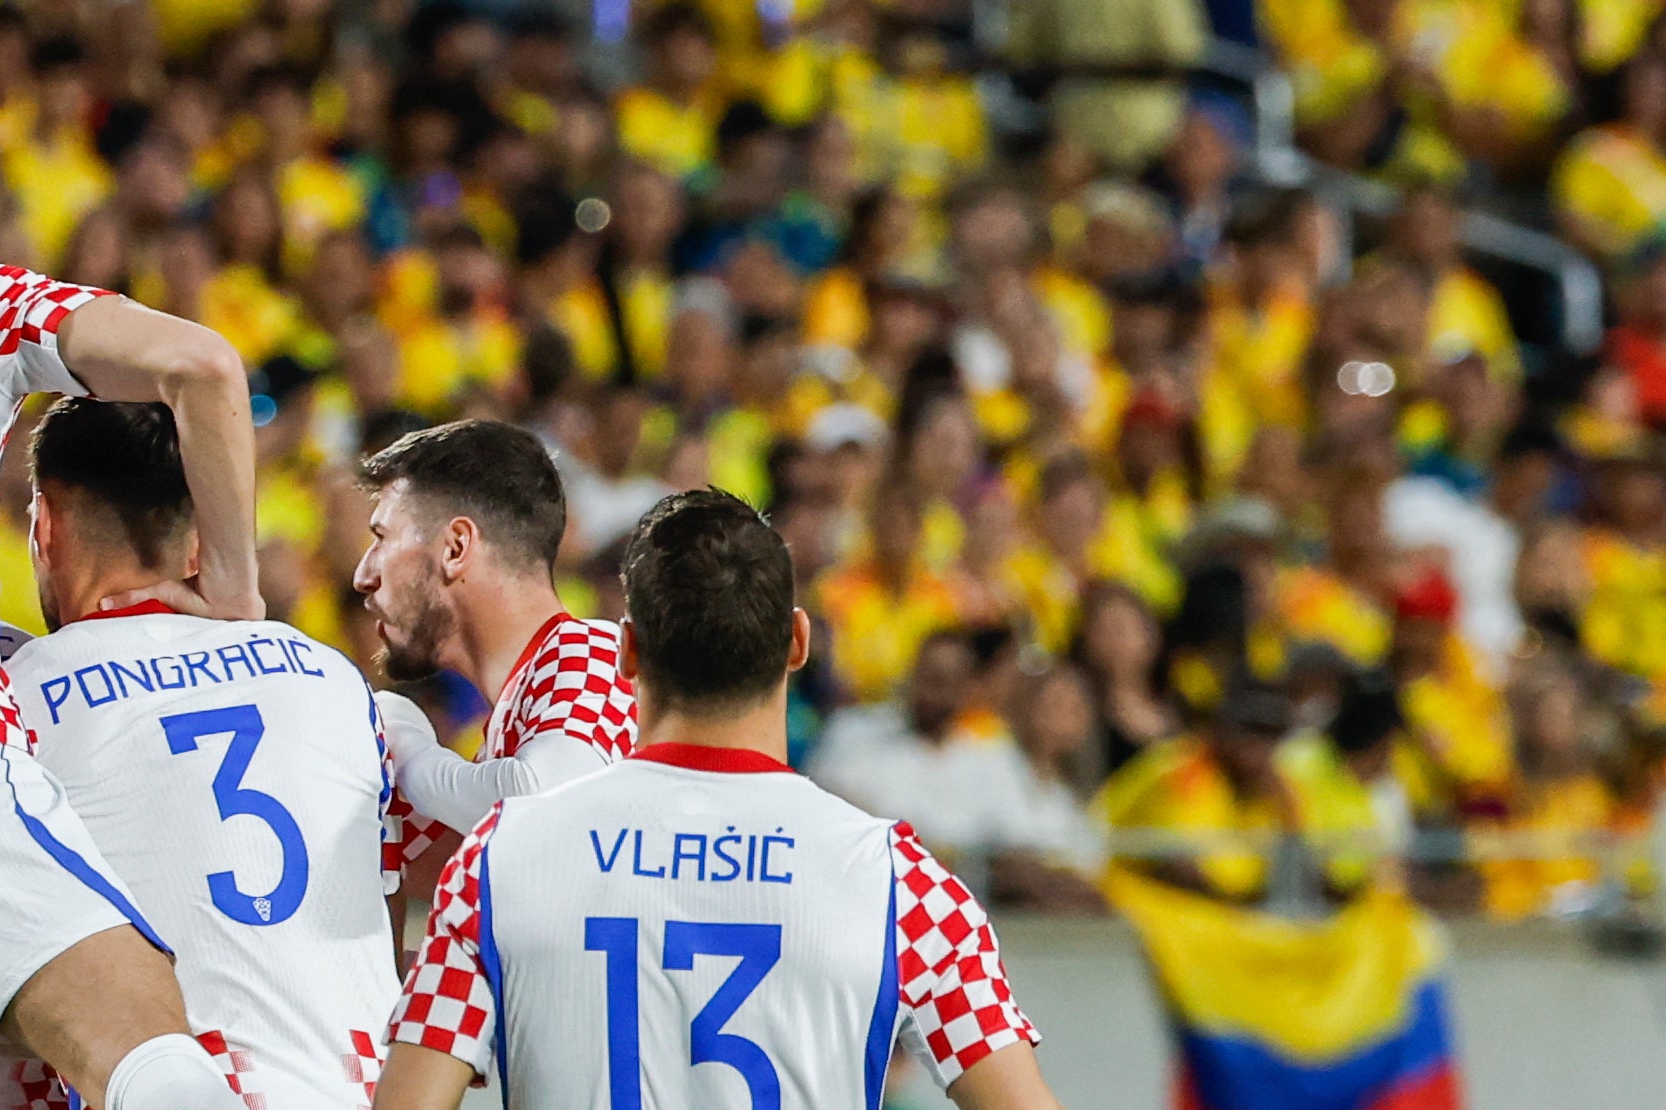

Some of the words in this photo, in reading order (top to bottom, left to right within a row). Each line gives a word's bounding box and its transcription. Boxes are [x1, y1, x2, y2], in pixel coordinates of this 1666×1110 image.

[40, 633, 325, 726] PONGRAČIĆ
[159, 704, 309, 927] 3
[589, 825, 795, 884] VLAŠIĆ
